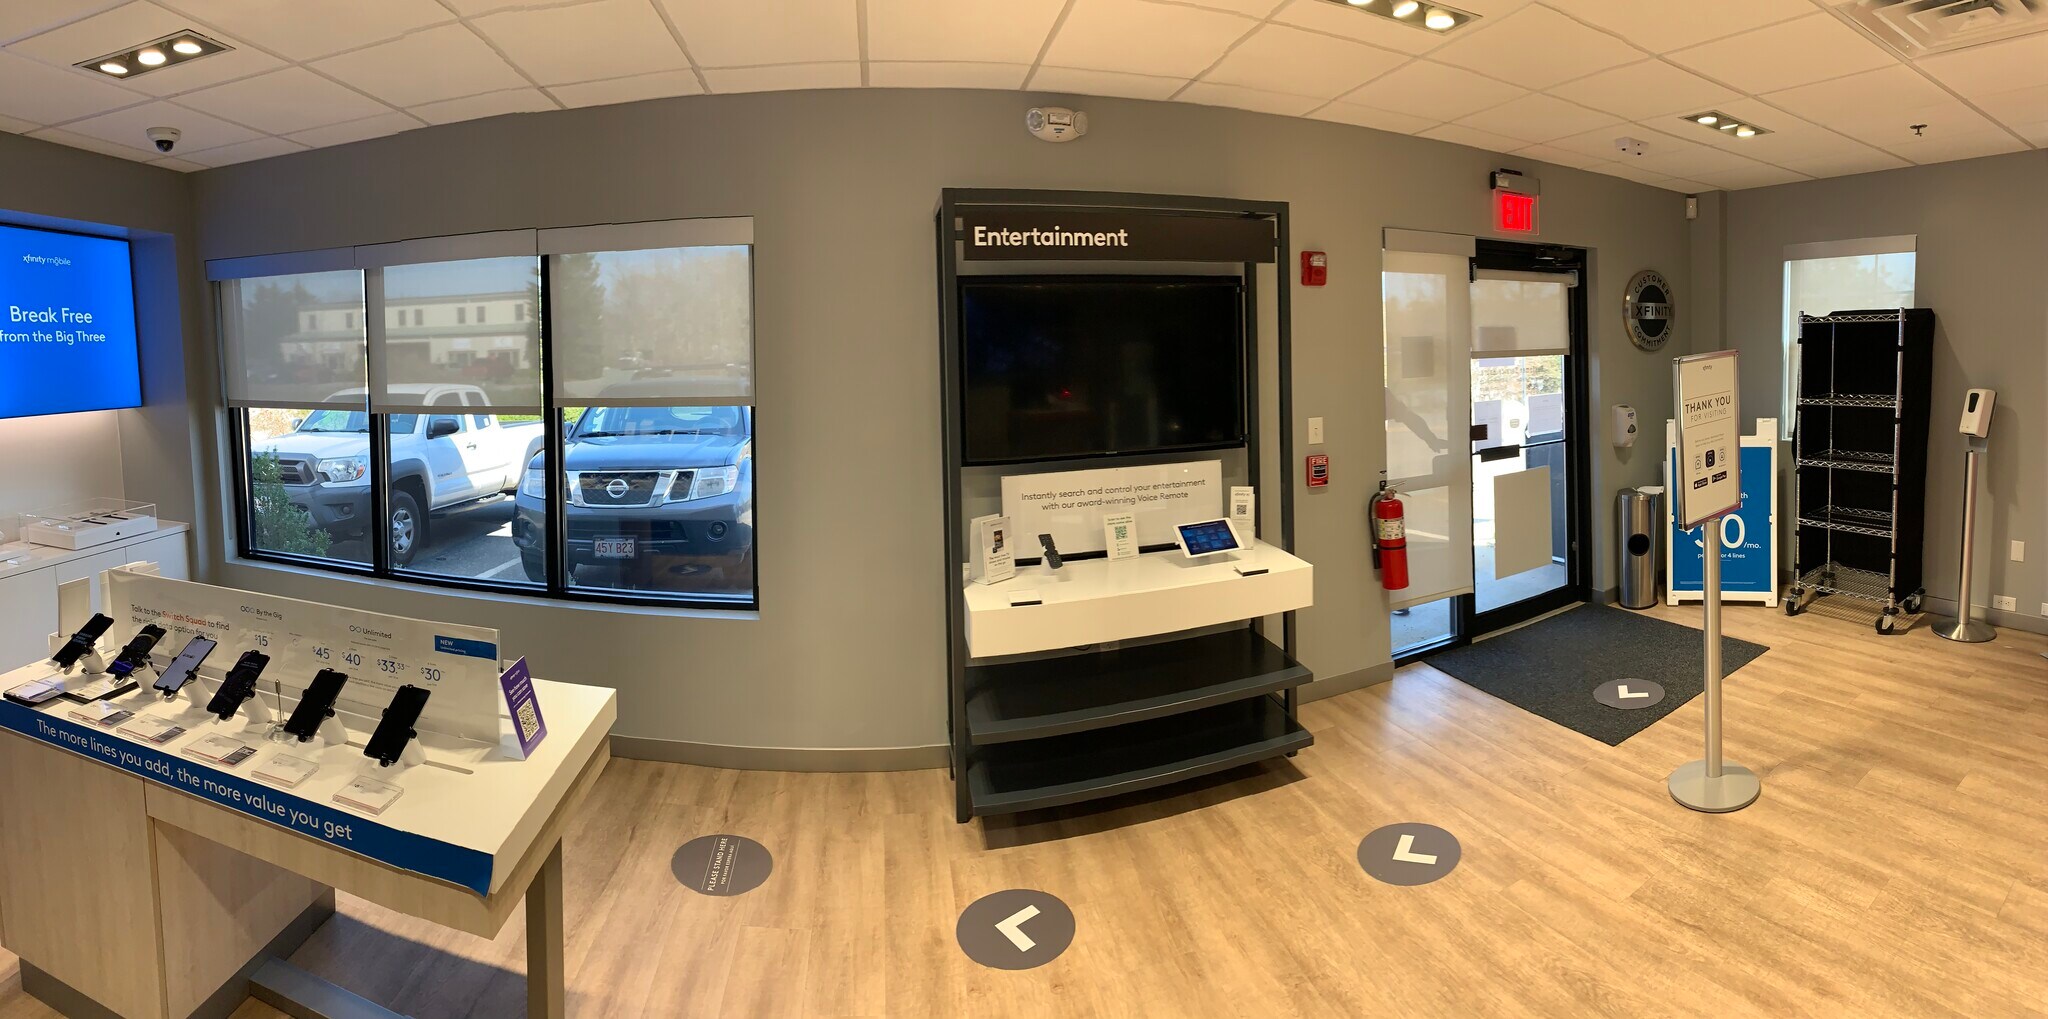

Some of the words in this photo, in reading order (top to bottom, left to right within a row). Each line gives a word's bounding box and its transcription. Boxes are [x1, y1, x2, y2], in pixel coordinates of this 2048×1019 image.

[1502, 193, 1534, 231] EXIT
[974, 225, 1129, 247] Entertainment
[22, 253, 46, 264] xfinity
[46, 256, 71, 266] mobile
[1634, 274, 1670, 296] CUSTOMER
[10, 305, 58, 323] Break
[61, 307, 93, 324] Free
[1635, 305, 1672, 317] XFINITY
[0, 329, 30, 342] from
[32, 330, 53, 342] the
[55, 330, 74, 346] Big
[75, 330, 106, 342] Three
[1634, 325, 1671, 347] COMMITMENT
[1685, 398, 1713, 414] THANK
[1715, 395, 1731, 407] YOU
[1690, 413, 1702, 422] FOR
[1704, 407, 1727, 418] VISITING
[1311, 457, 1328, 465] FIRE
[1021, 491, 1057, 501] Instantly
[1058, 489, 1085, 498] search
[1087, 487, 1103, 496] and
[1105, 485, 1132, 494] control
[1133, 485, 1151, 493] your
[1152, 479, 1206, 490] entertainment
[1041, 502, 1060, 510] with
[1076, 496, 1136, 508] award-winning
[1137, 494, 1158, 502] Voice
[1160, 491, 1189, 500] Remote
[596, 542, 613, 554] 45Y
[616, 542, 634, 554] B23
[131, 604, 143, 613] Talk
[151, 609, 161, 617] the
[162, 610, 184, 621] Switch
[185, 614, 206, 626] Squad
[208, 620, 215, 628] to
[216, 620, 230, 631] find
[256, 609, 263, 617] By
[132, 616, 142, 624] the
[174, 625, 195, 635] option
[196, 628, 205, 636] for
[205, 632, 219, 640] you
[362, 627, 392, 639] Unlimited
[255, 634, 268, 647] $15
[312, 646, 330, 660] $45
[341, 652, 361, 666] $40
[421, 667, 441, 681] $30
[37, 719, 56, 737] The
[59, 730, 88, 748] more
[90, 737, 117, 758] lines
[119, 750, 141, 767] you
[145, 760, 174, 780] add,
[177, 768, 200, 787] the
[204, 779, 241, 801] more
[244, 793, 286, 817] value
[289, 808, 319, 829] you
[323, 821, 352, 841] get
[707, 870, 719, 891] PLEASE
[713, 851, 724, 870] STAND
[719, 837, 728, 851] HERE
